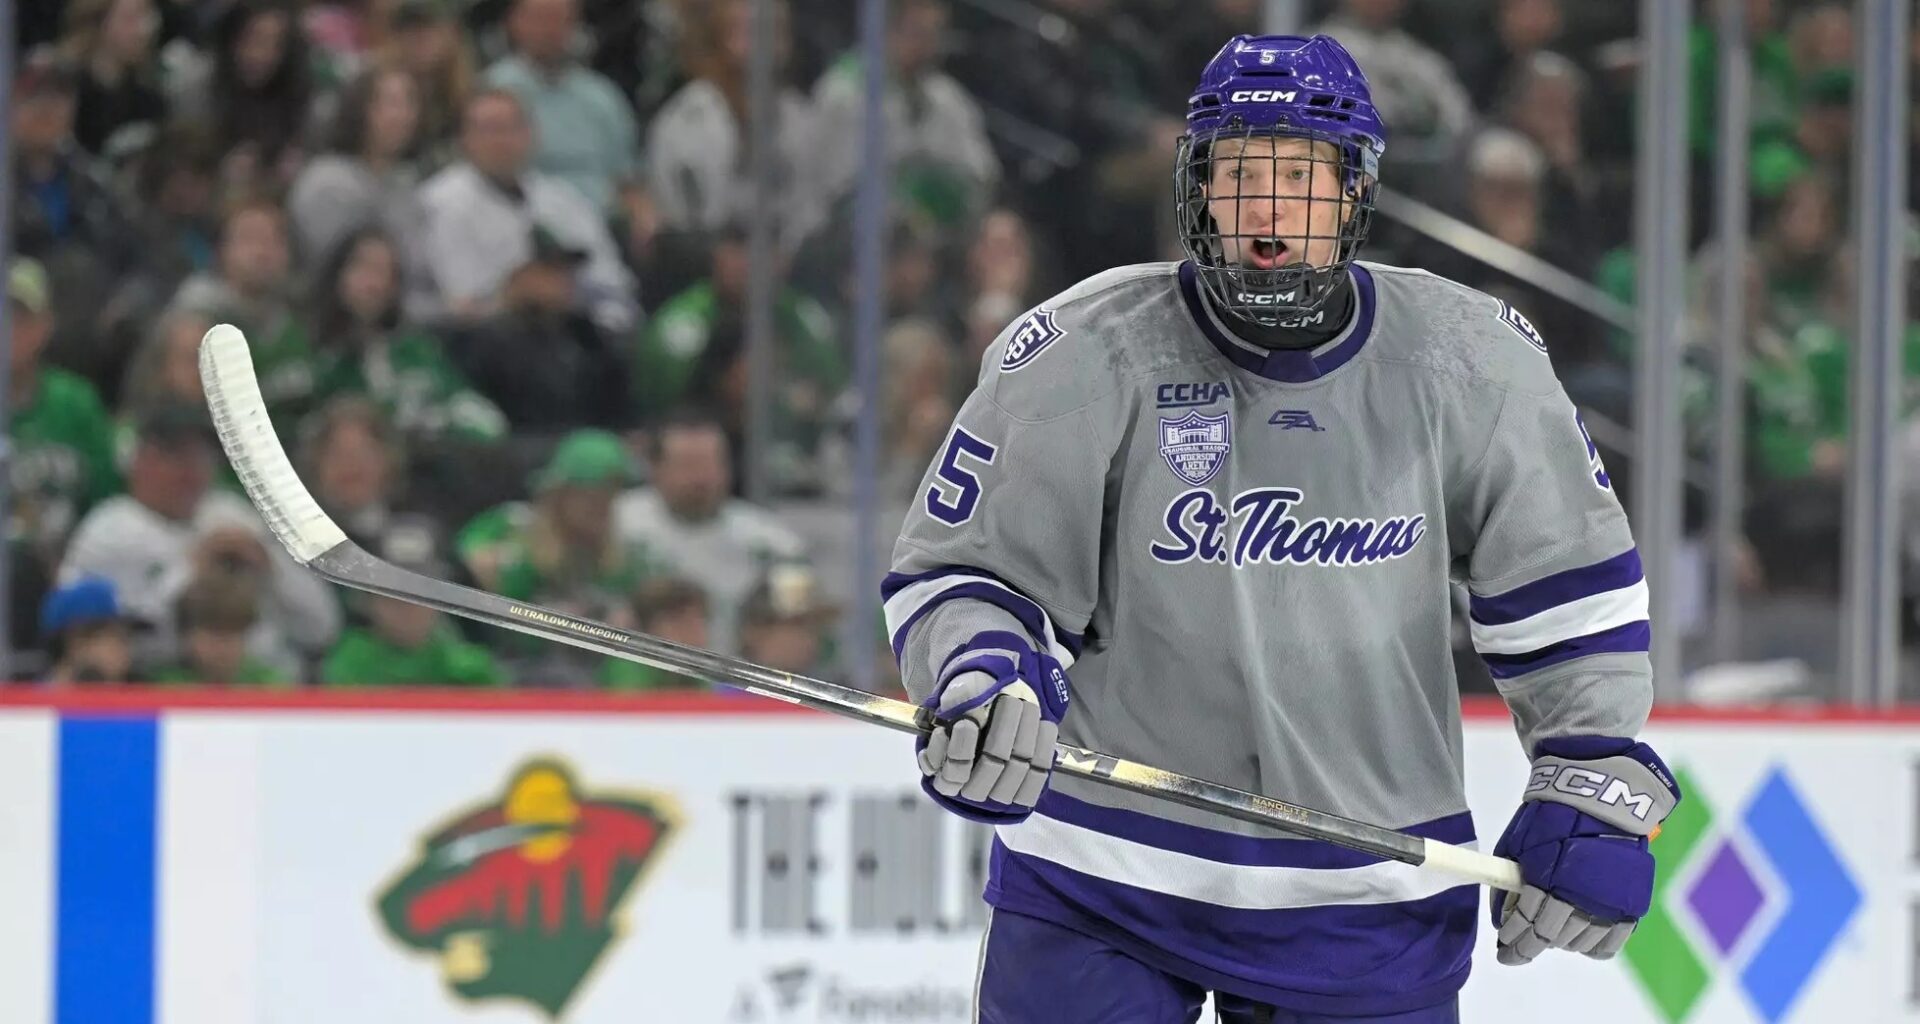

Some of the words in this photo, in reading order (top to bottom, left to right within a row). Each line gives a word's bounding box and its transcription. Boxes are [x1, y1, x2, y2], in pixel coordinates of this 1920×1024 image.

[1259, 50, 1276, 65] 5
[1231, 90, 1297, 103] CCM
[1237, 291, 1296, 305] CCM
[1157, 382, 1231, 404] CCHA
[1175, 453, 1217, 463] ANDERSON
[1182, 461, 1211, 471] ARENA
[924, 423, 999, 528] 5
[1231, 486, 1426, 570] Thomas
[510, 605, 570, 628] ULTRALOW
[570, 621, 630, 644] KICKPOINT
[1052, 668, 1069, 702] CCM
[1525, 764, 1656, 822] CCM
